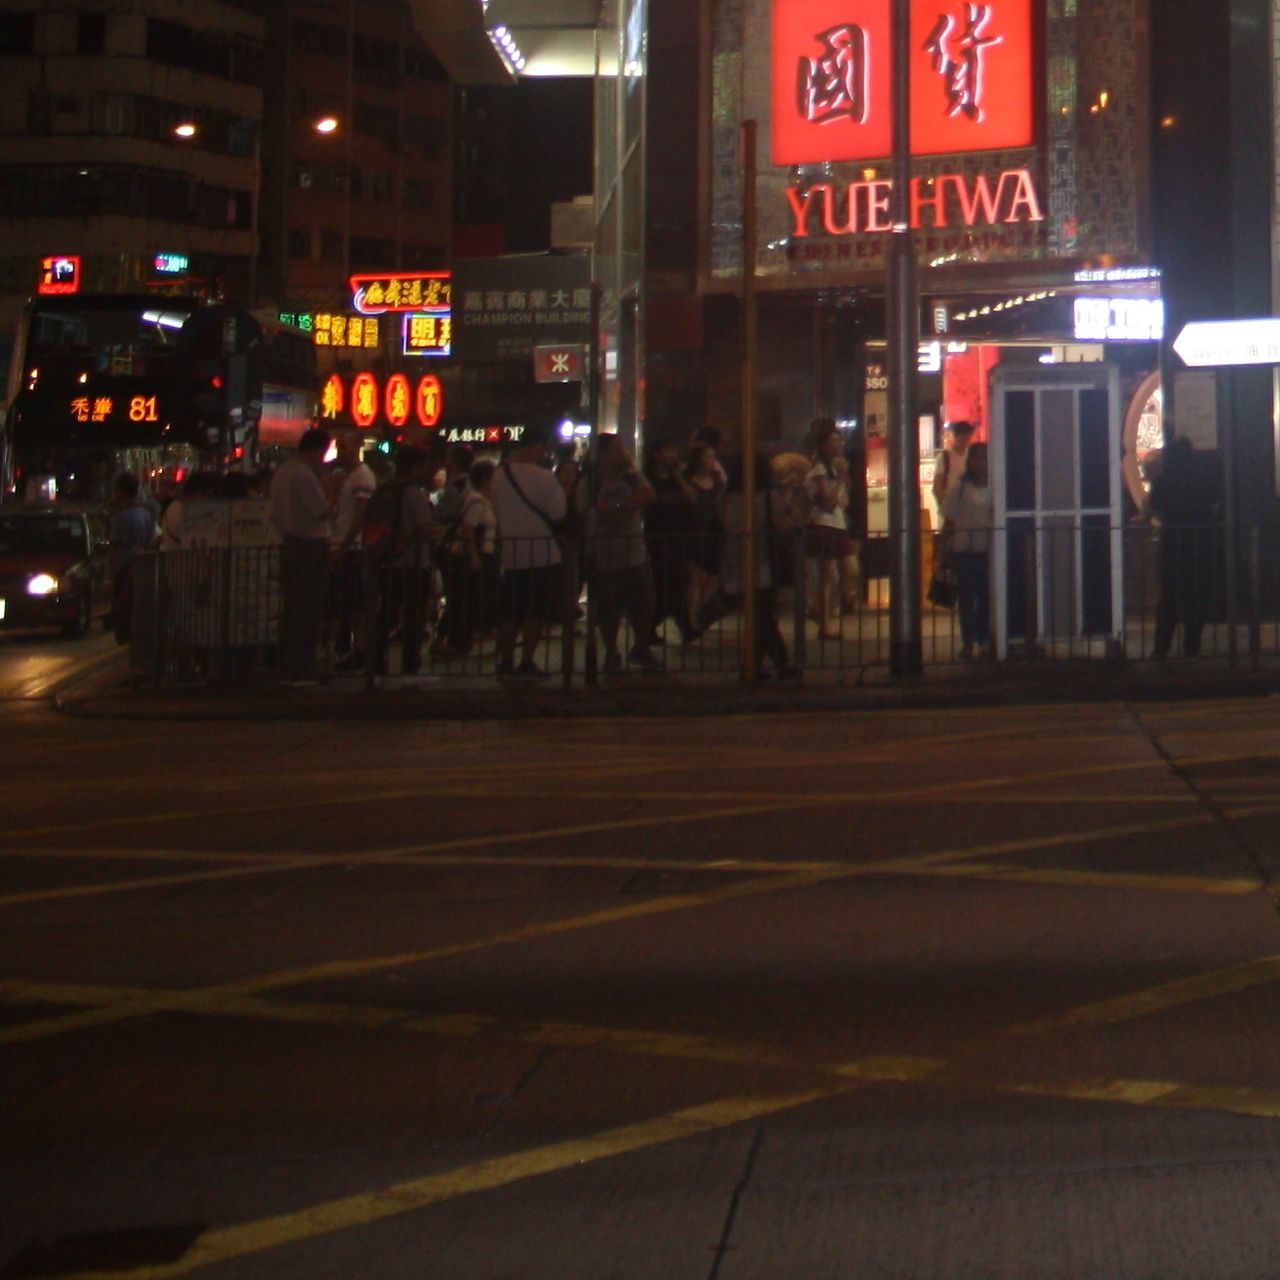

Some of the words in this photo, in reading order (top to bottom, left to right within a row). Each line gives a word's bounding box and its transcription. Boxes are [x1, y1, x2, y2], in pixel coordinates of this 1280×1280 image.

[784, 179, 893, 238] YUE
[909, 169, 1045, 231] HWA
[129, 395, 159, 421] 81
